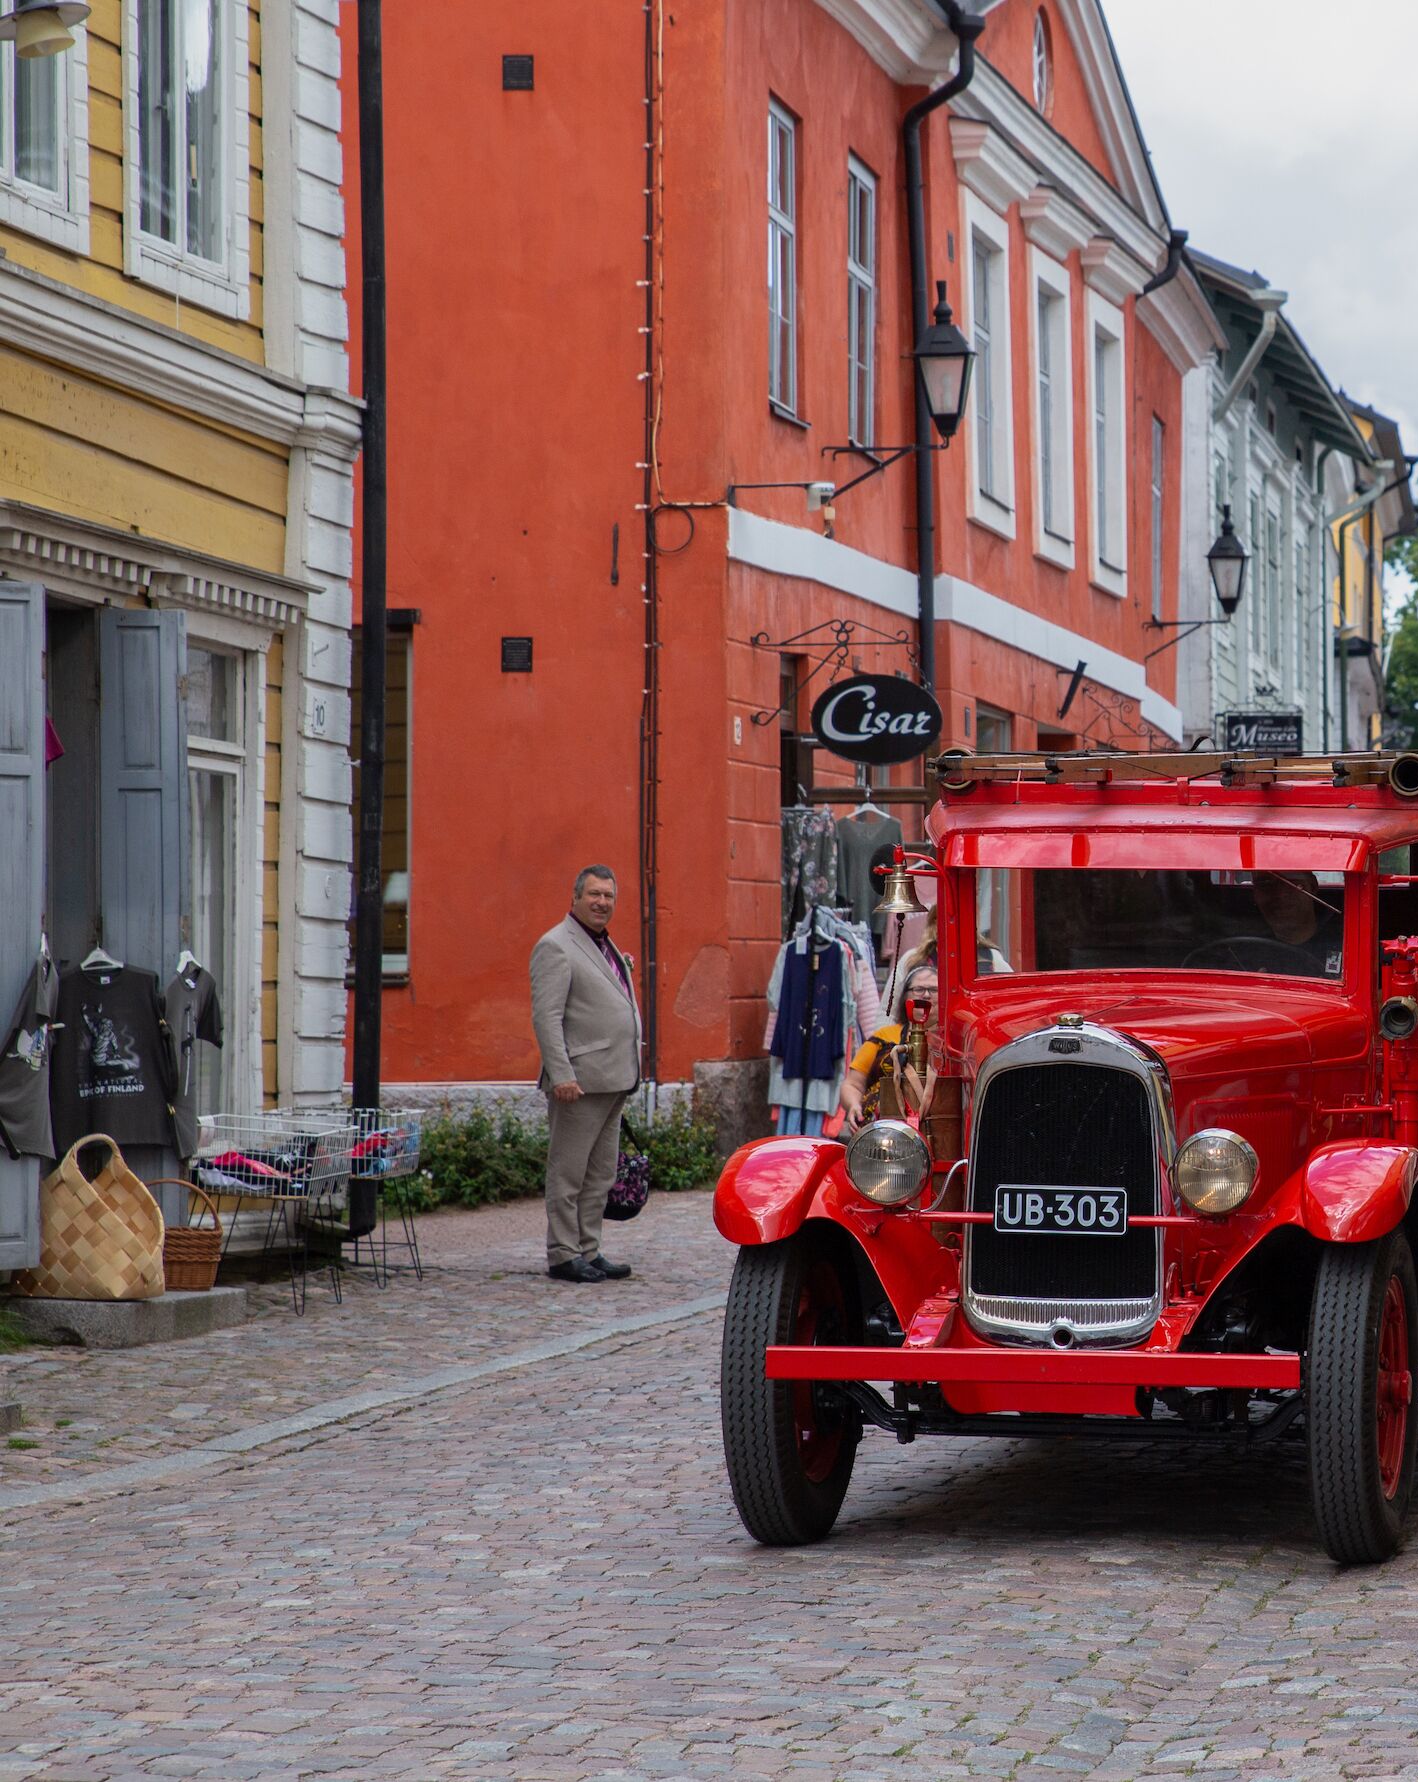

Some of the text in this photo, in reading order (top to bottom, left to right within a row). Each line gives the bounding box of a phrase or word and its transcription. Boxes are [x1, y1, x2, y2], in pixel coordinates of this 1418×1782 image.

[316, 705, 325, 727] 10
[821, 684, 931, 741] Cisar
[1230, 723, 1298, 746] Museo
[95, 1085, 105, 1094] OF
[107, 1084, 144, 1093] FINLAND
